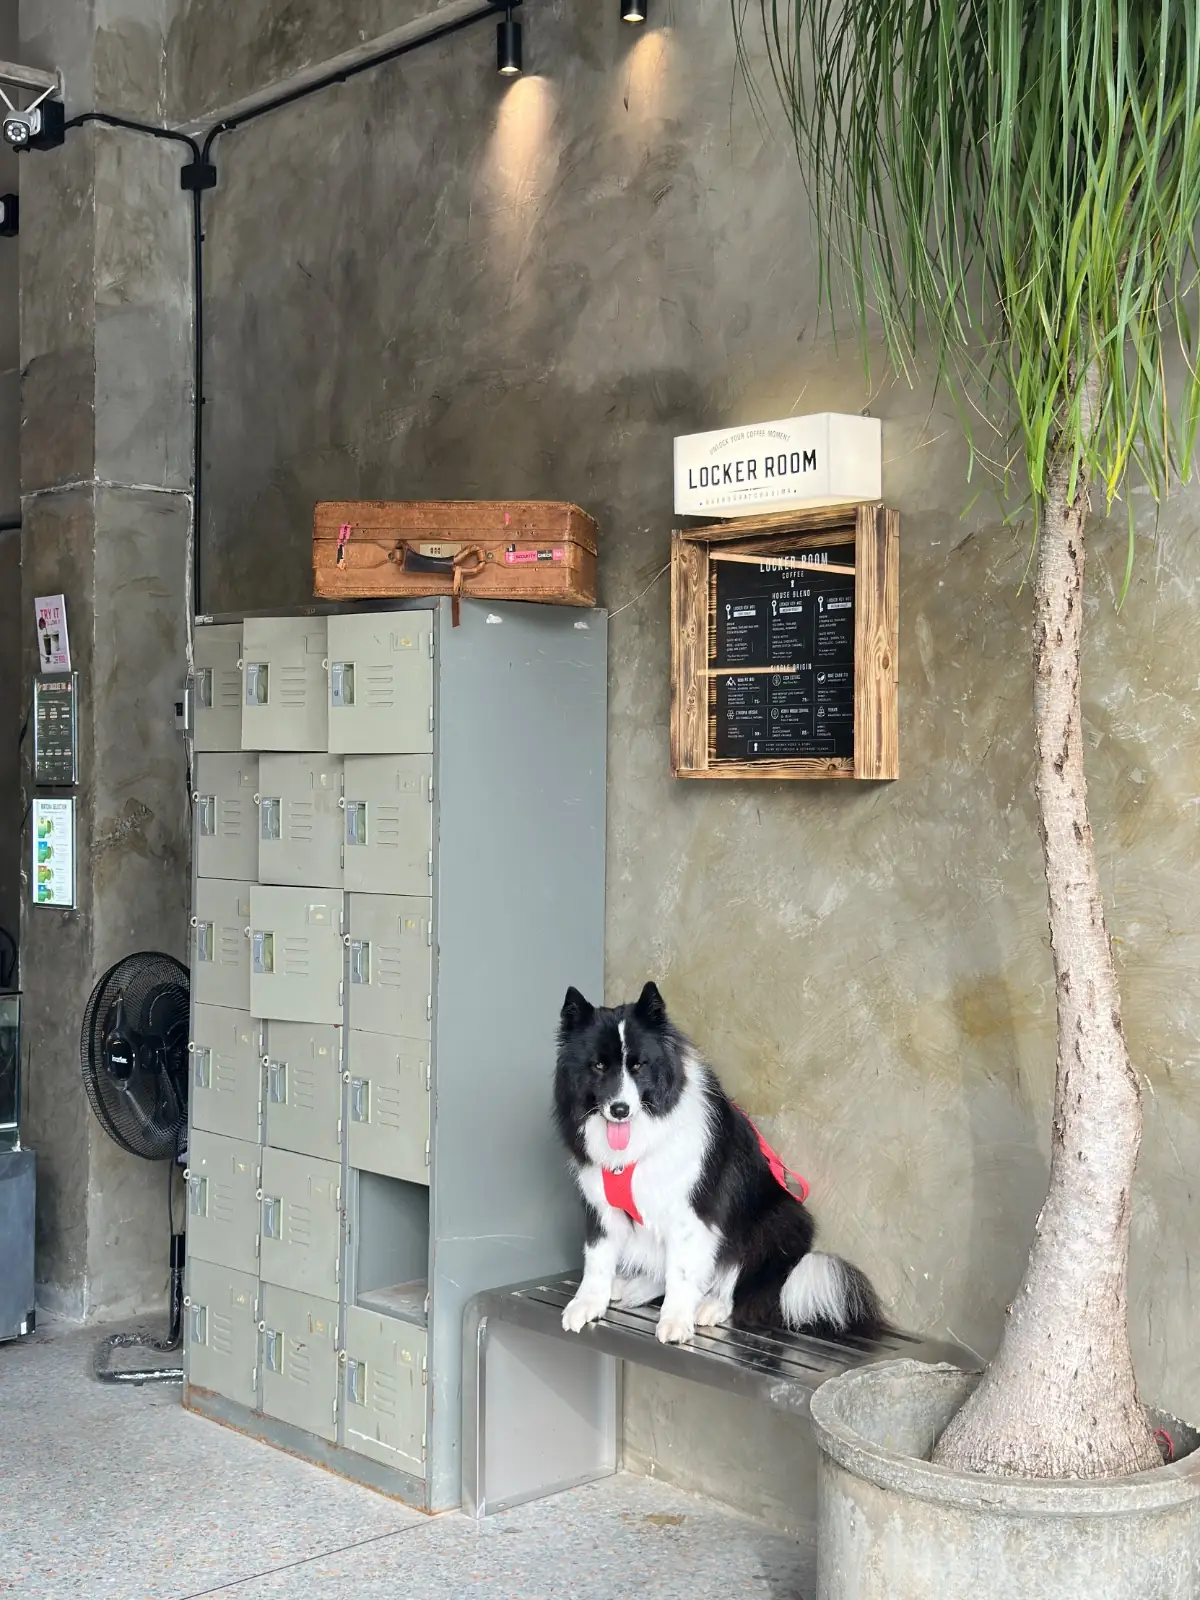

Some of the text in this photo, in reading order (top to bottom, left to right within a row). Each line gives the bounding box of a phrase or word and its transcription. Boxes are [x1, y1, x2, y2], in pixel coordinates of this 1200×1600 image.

[708, 429, 792, 456] UNLOCK YOUR COFFEE MOMENT
[688, 449, 817, 490] LOCKER ROOM
[760, 552, 828, 572] LOCKER ROOM
[782, 570, 804, 579] COFFEE
[772, 589, 811, 600] HOUSE BLEND
[40, 607, 60, 620] TRY IT
[792, 663, 812, 671] ORIGIN
